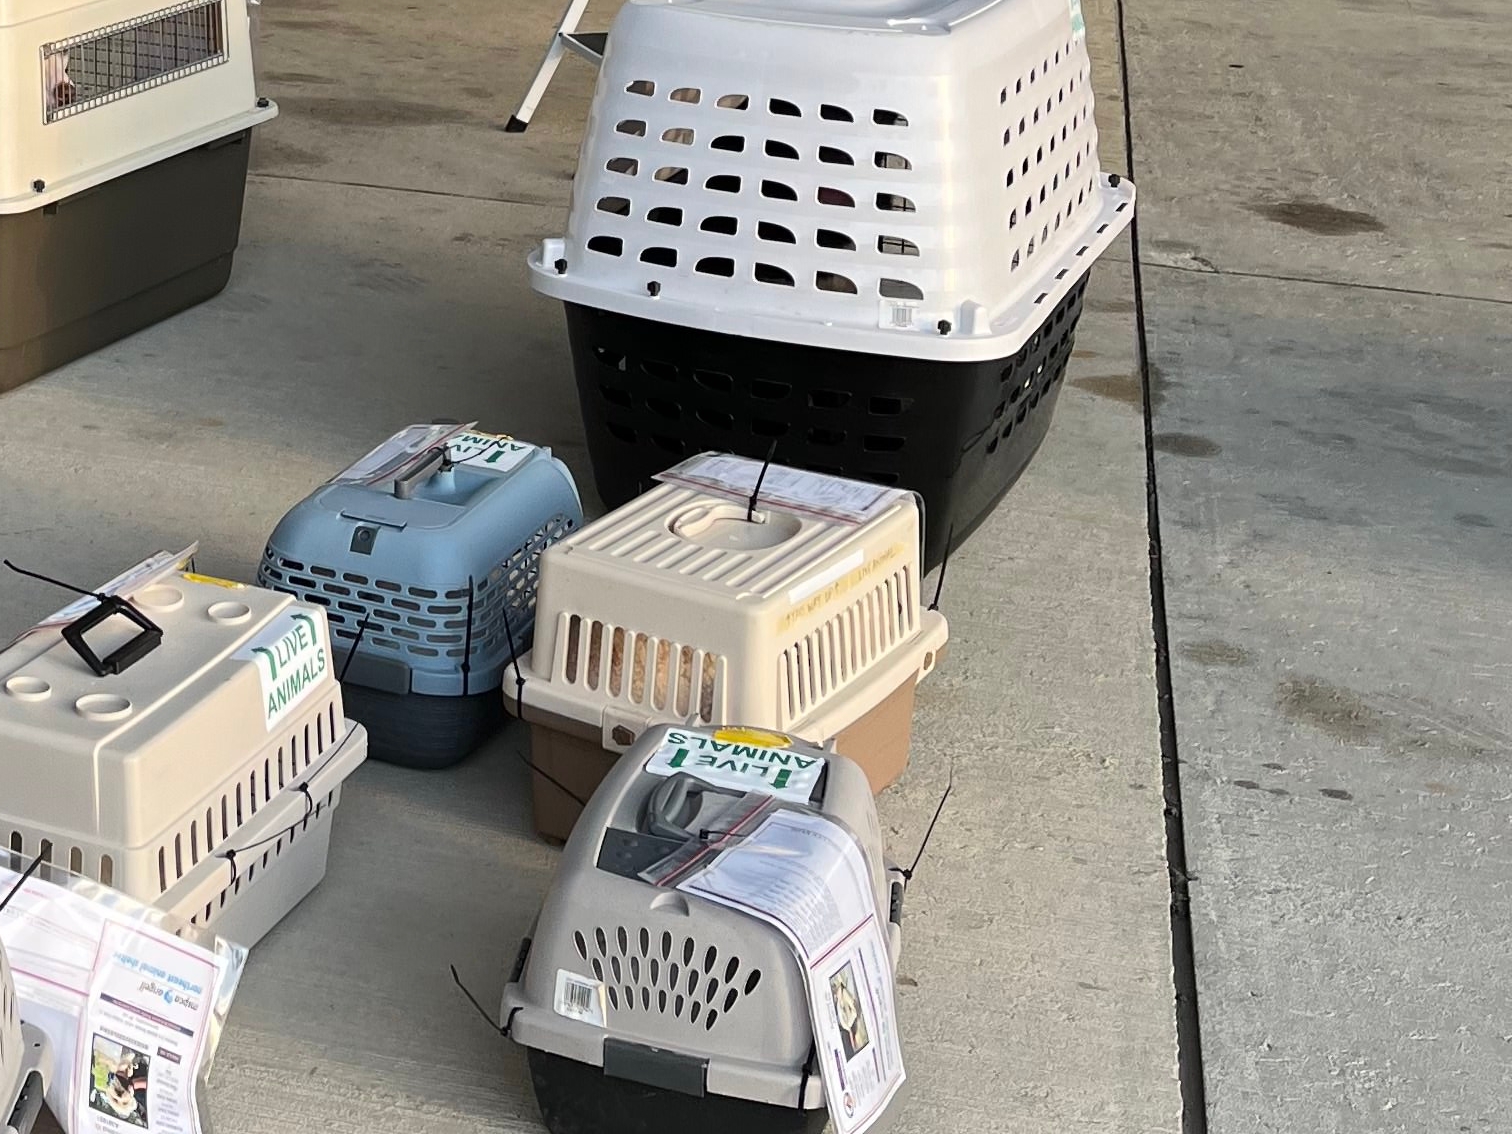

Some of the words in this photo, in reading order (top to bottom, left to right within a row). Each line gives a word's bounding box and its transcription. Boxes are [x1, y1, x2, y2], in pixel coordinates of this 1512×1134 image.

[275, 624, 308, 668] LIVE
[268, 648, 325, 720] ANIMALS
[668, 732, 817, 769] ANIMALS
[695, 755, 769, 777] LIVE
